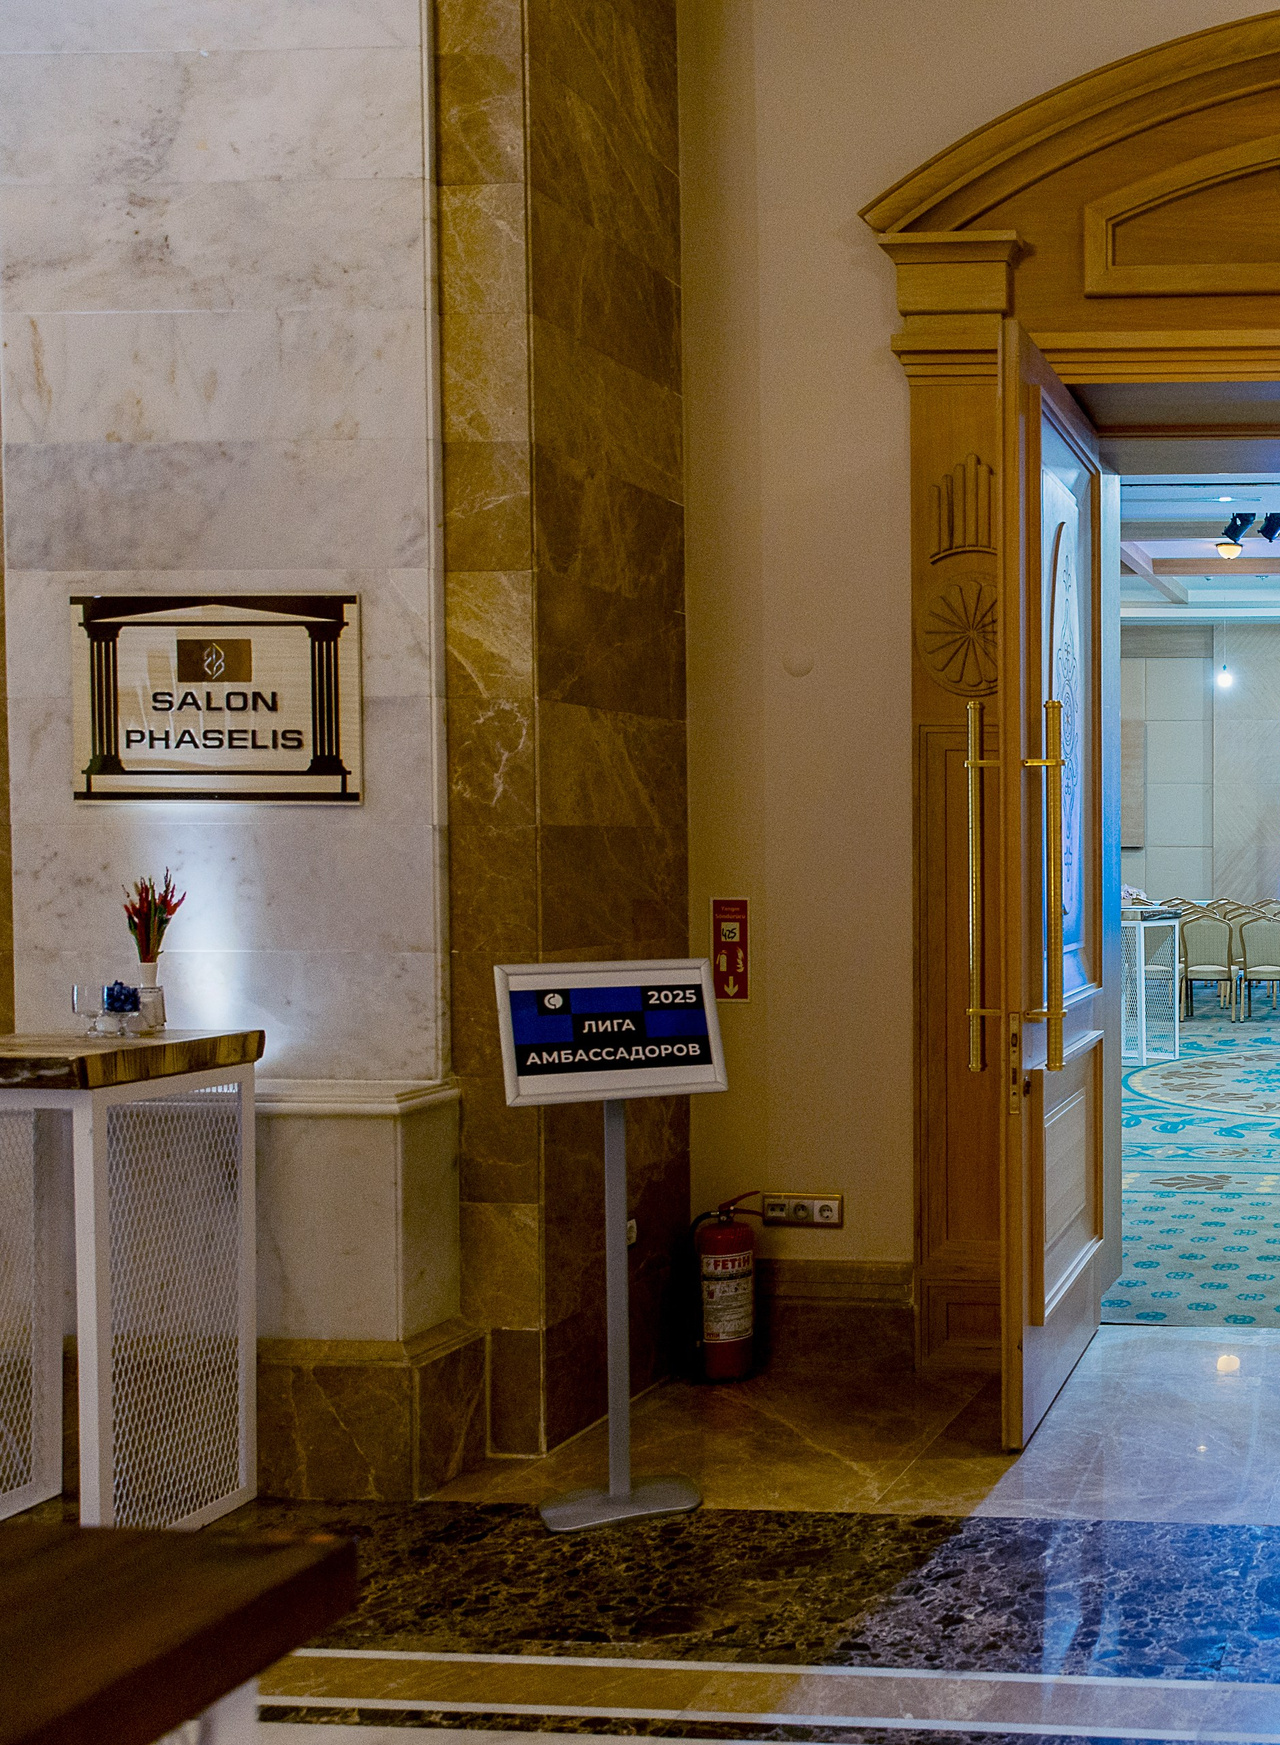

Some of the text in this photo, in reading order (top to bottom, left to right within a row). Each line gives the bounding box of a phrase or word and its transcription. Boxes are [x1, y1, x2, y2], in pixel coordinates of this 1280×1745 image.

[151, 691, 279, 712] SALON
[125, 728, 304, 750] PHASELIS
[721, 928, 737, 940] 425
[647, 989, 697, 1005] 2025
[582, 1018, 636, 1034] ЛИГА
[526, 1043, 701, 1066] АМБАССАДОРОВ
